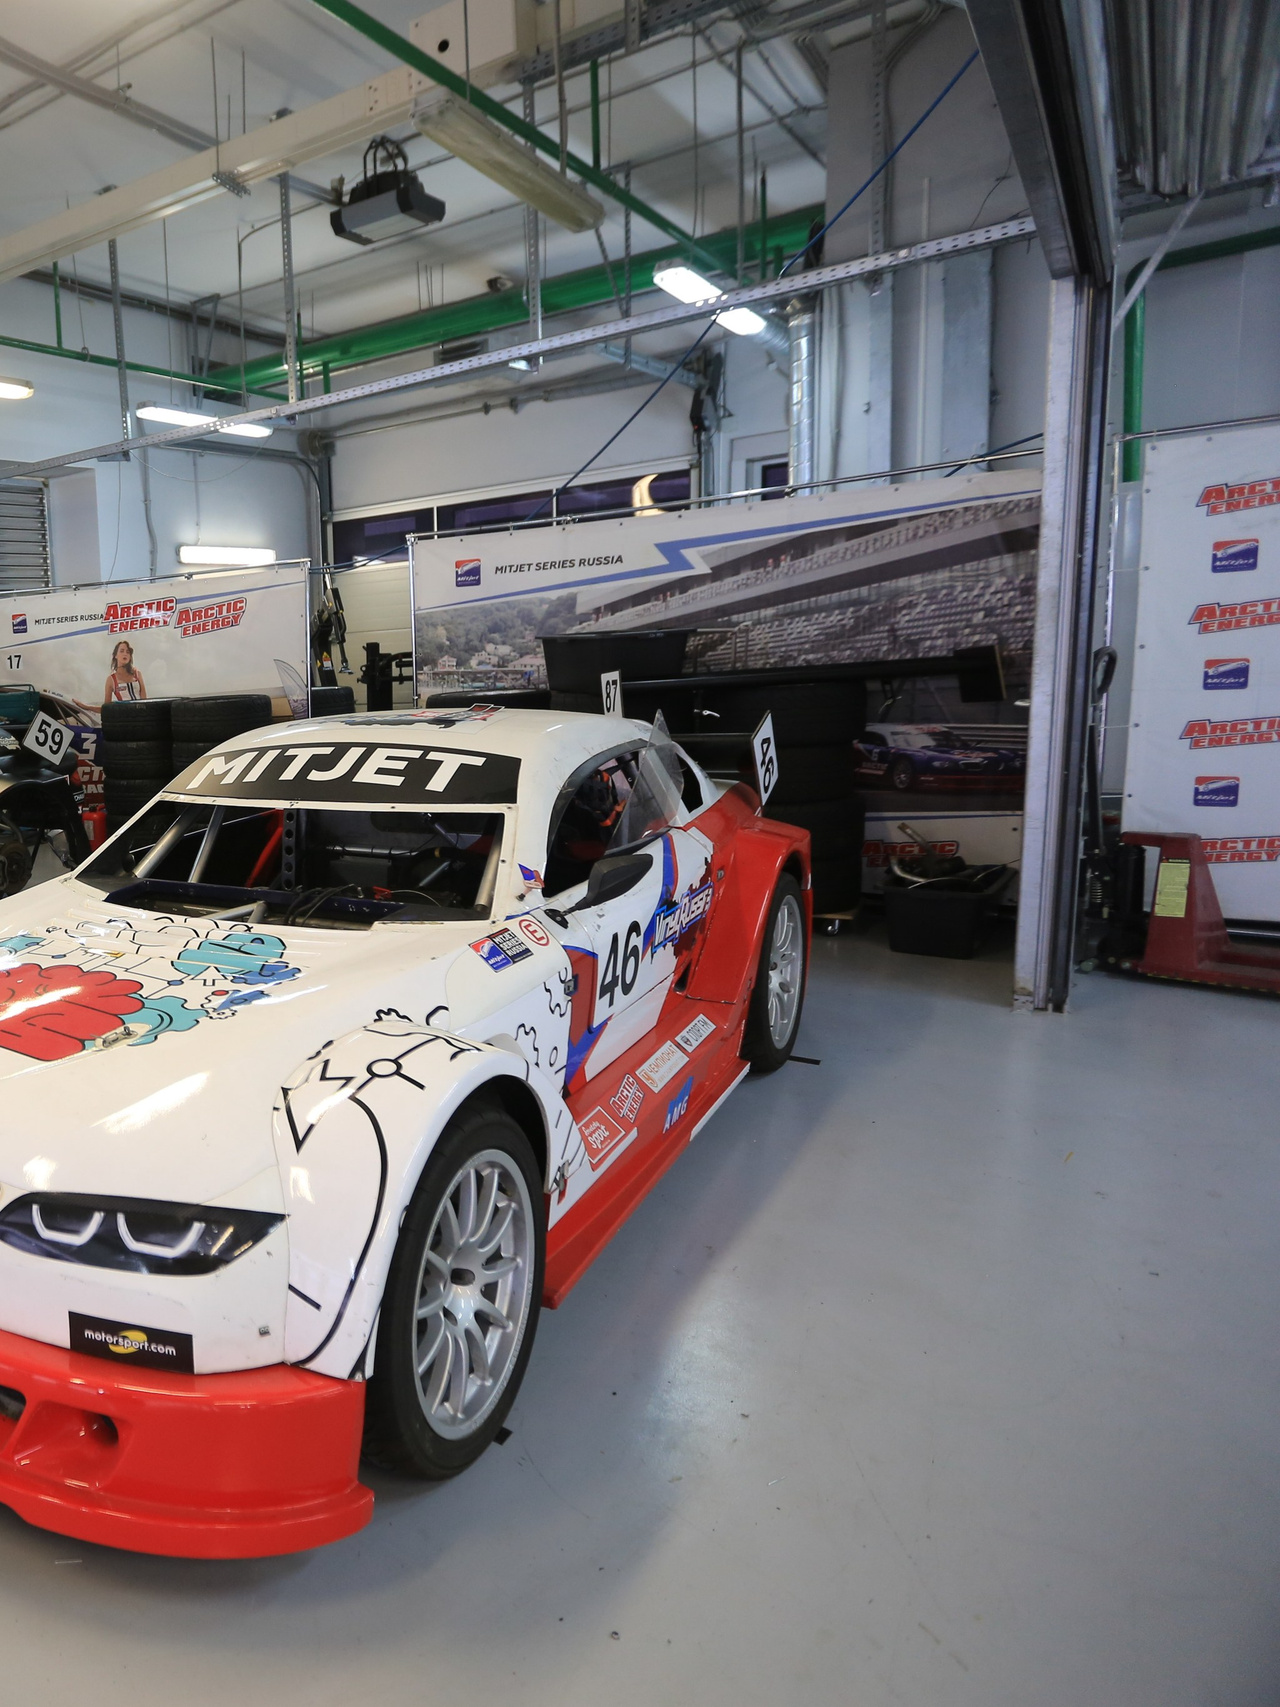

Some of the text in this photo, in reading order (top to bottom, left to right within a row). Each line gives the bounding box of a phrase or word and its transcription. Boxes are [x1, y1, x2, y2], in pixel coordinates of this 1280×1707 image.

[494, 555, 624, 575] MITJET SERIES RUSSIA
[34, 613, 104, 626] MITJET SERIES RUSSIA
[103, 598, 176, 621] ARCTIC
[176, 599, 246, 626] ARCTIC
[109, 614, 171, 634] ENERGY
[182, 612, 243, 637] ENERGY
[7, 654, 22, 670] 17
[605, 679, 618, 714] 87
[35, 719, 64, 755] 59
[1184, 718, 1280, 738] ARCTI
[186, 746, 488, 793] MITJET
[761, 737, 775, 794] 46
[1201, 837, 1280, 852] RCTIC
[492, 931, 517, 945] MITJET
[499, 936, 522, 951] SERIES
[505, 943, 528, 957] RUSSIA
[599, 920, 642, 1008] 46
[648, 1044, 678, 1074] ЧЕМПИОНАТ
[612, 1074, 635, 1115] ARCTIC
[625, 1085, 644, 1120] ENERGY
[663, 1096, 689, 1134] AMG
[84, 1329, 177, 1356] motorsport.com
